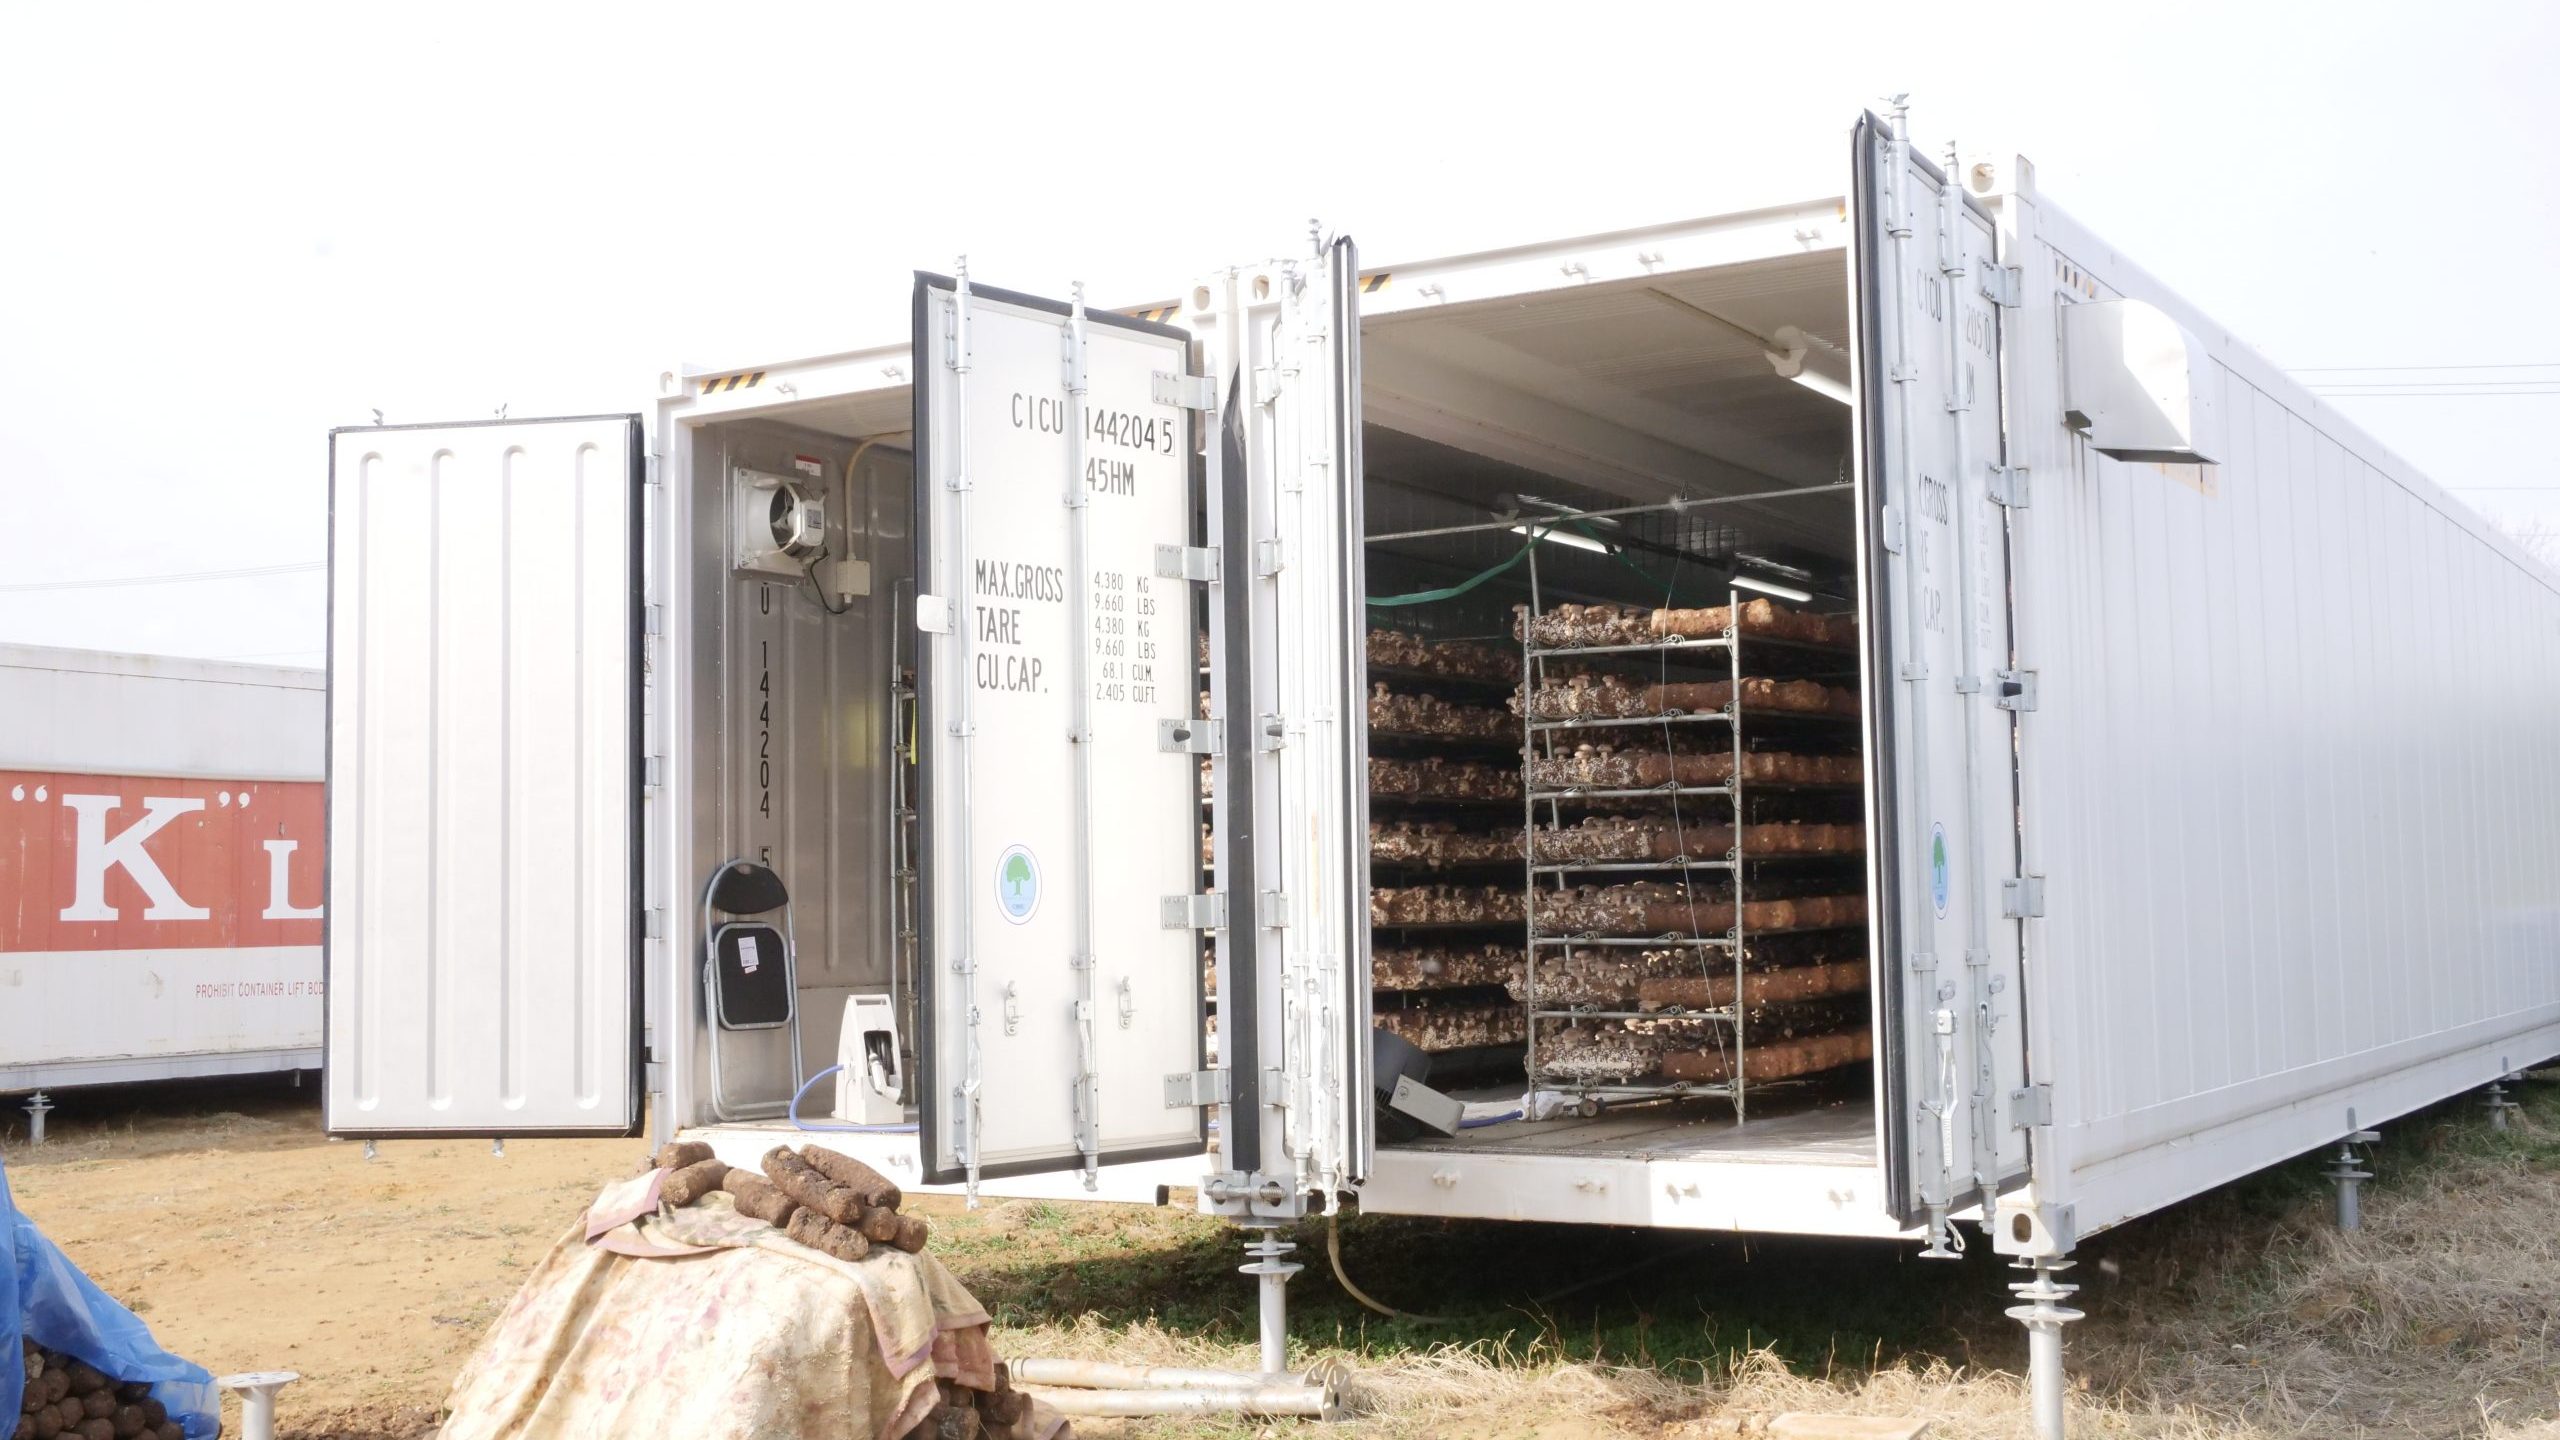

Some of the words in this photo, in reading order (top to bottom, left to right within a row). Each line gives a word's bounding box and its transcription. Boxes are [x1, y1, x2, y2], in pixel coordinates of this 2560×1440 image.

[1012, 392, 1064, 434] CICU
[1085, 406, 1156, 451] 144204
[1162, 420, 1173, 453] 5
[1086, 457, 1135, 496] 45HM
[975, 558, 1064, 603] MAX.GROSS
[1094, 571, 1124, 591] 4.380
[1137, 576, 1149, 594] KG
[1094, 592, 1124, 612] 9.660
[1137, 597, 1156, 616] LBS
[976, 605, 1022, 645] TARE
[1094, 616, 1124, 636] 4.380
[1137, 619, 1150, 638] KG
[1095, 637, 1125, 657] 9.660
[1138, 641, 1156, 660] LBS
[976, 652, 1049, 694] CU.CAP.
[1102, 661, 1124, 680] 68.1
[1096, 682, 1125, 702] 2.405
[759, 640, 770, 819] 144204
[262, 839, 324, 920] L
[195, 983, 236, 999] PROHIBIT
[238, 981, 285, 998] CONTAINER
[287, 981, 305, 997] LIFT
[307, 981, 324, 996] BOD
